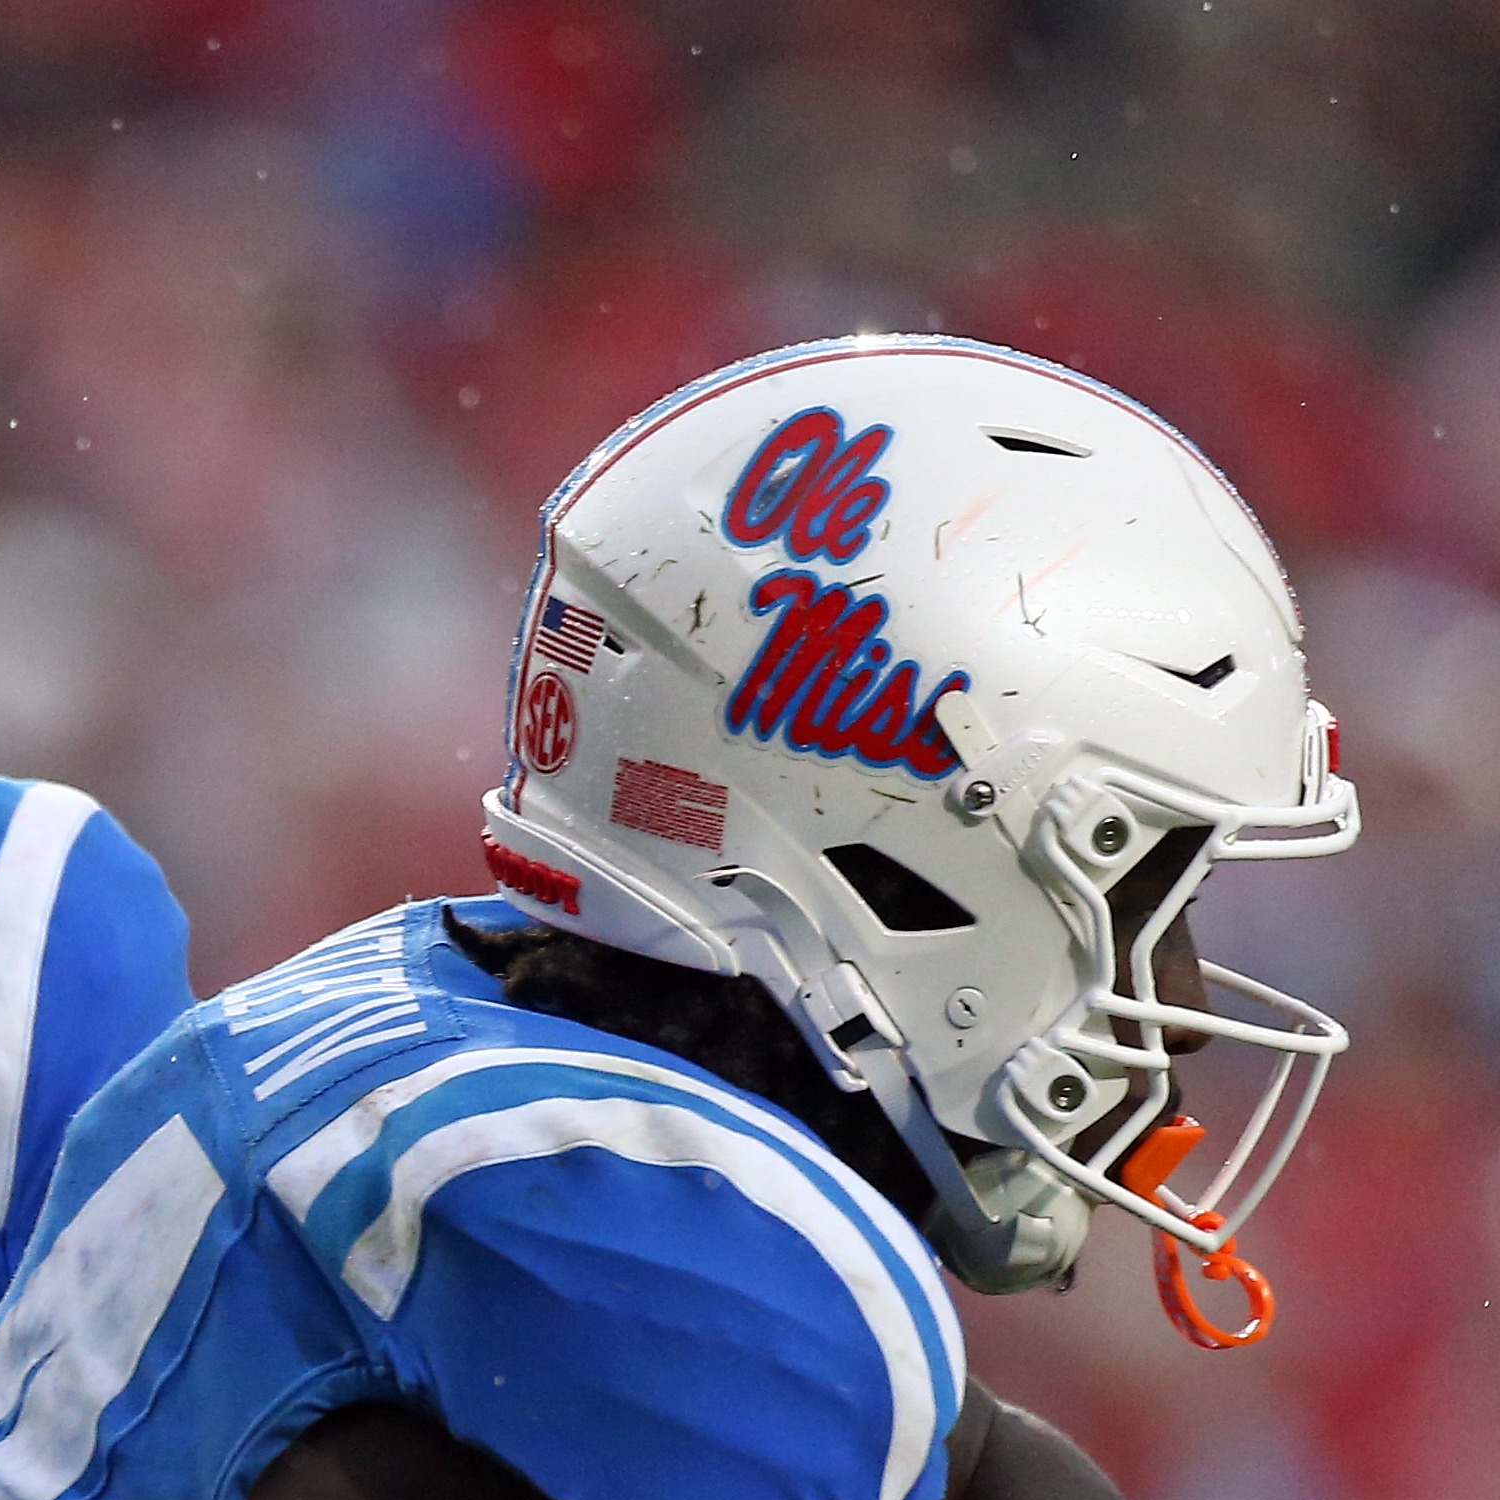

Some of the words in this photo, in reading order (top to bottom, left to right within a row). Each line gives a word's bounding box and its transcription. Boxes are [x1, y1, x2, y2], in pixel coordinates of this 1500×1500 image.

[722, 405, 895, 566] Ole
[524, 675, 571, 769] SEC
[724, 567, 972, 782] Miss
